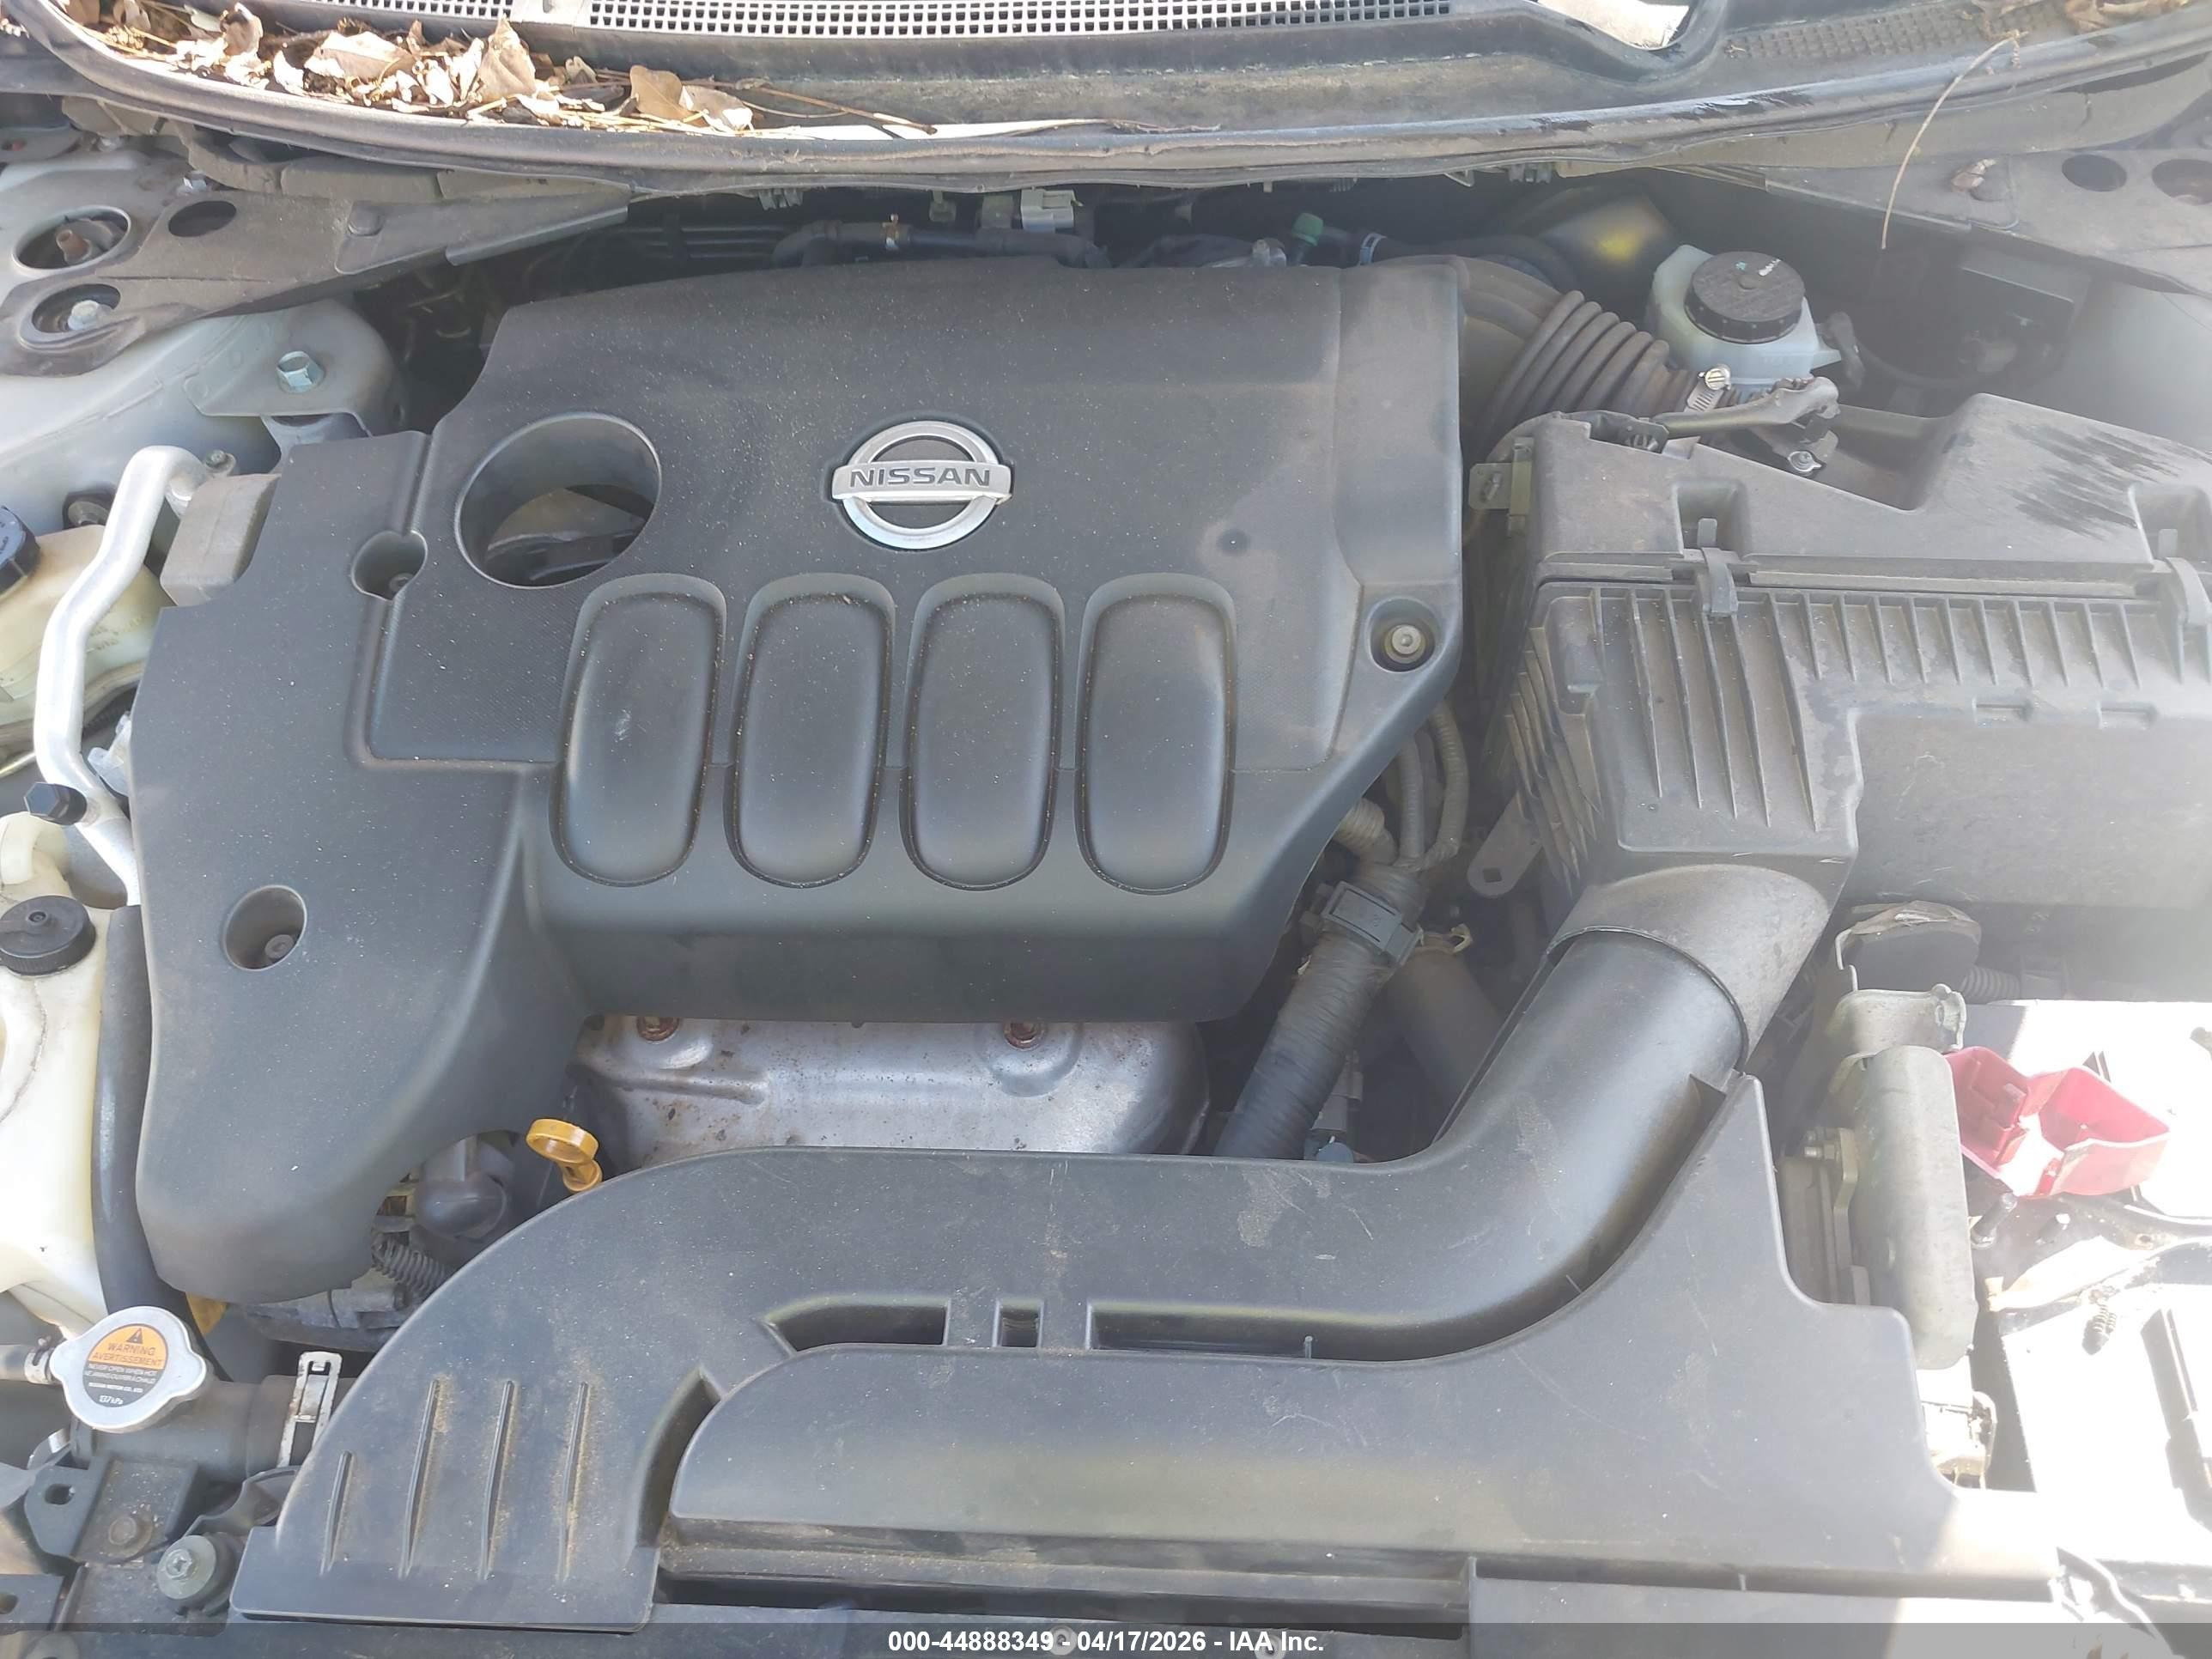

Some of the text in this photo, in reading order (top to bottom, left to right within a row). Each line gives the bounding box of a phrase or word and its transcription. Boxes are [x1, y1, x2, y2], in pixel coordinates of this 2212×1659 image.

[849, 467, 990, 488] NISSAN
[108, 1343, 155, 1356] WARNING
[92, 1352, 163, 1366] AVERTISSEMENT
